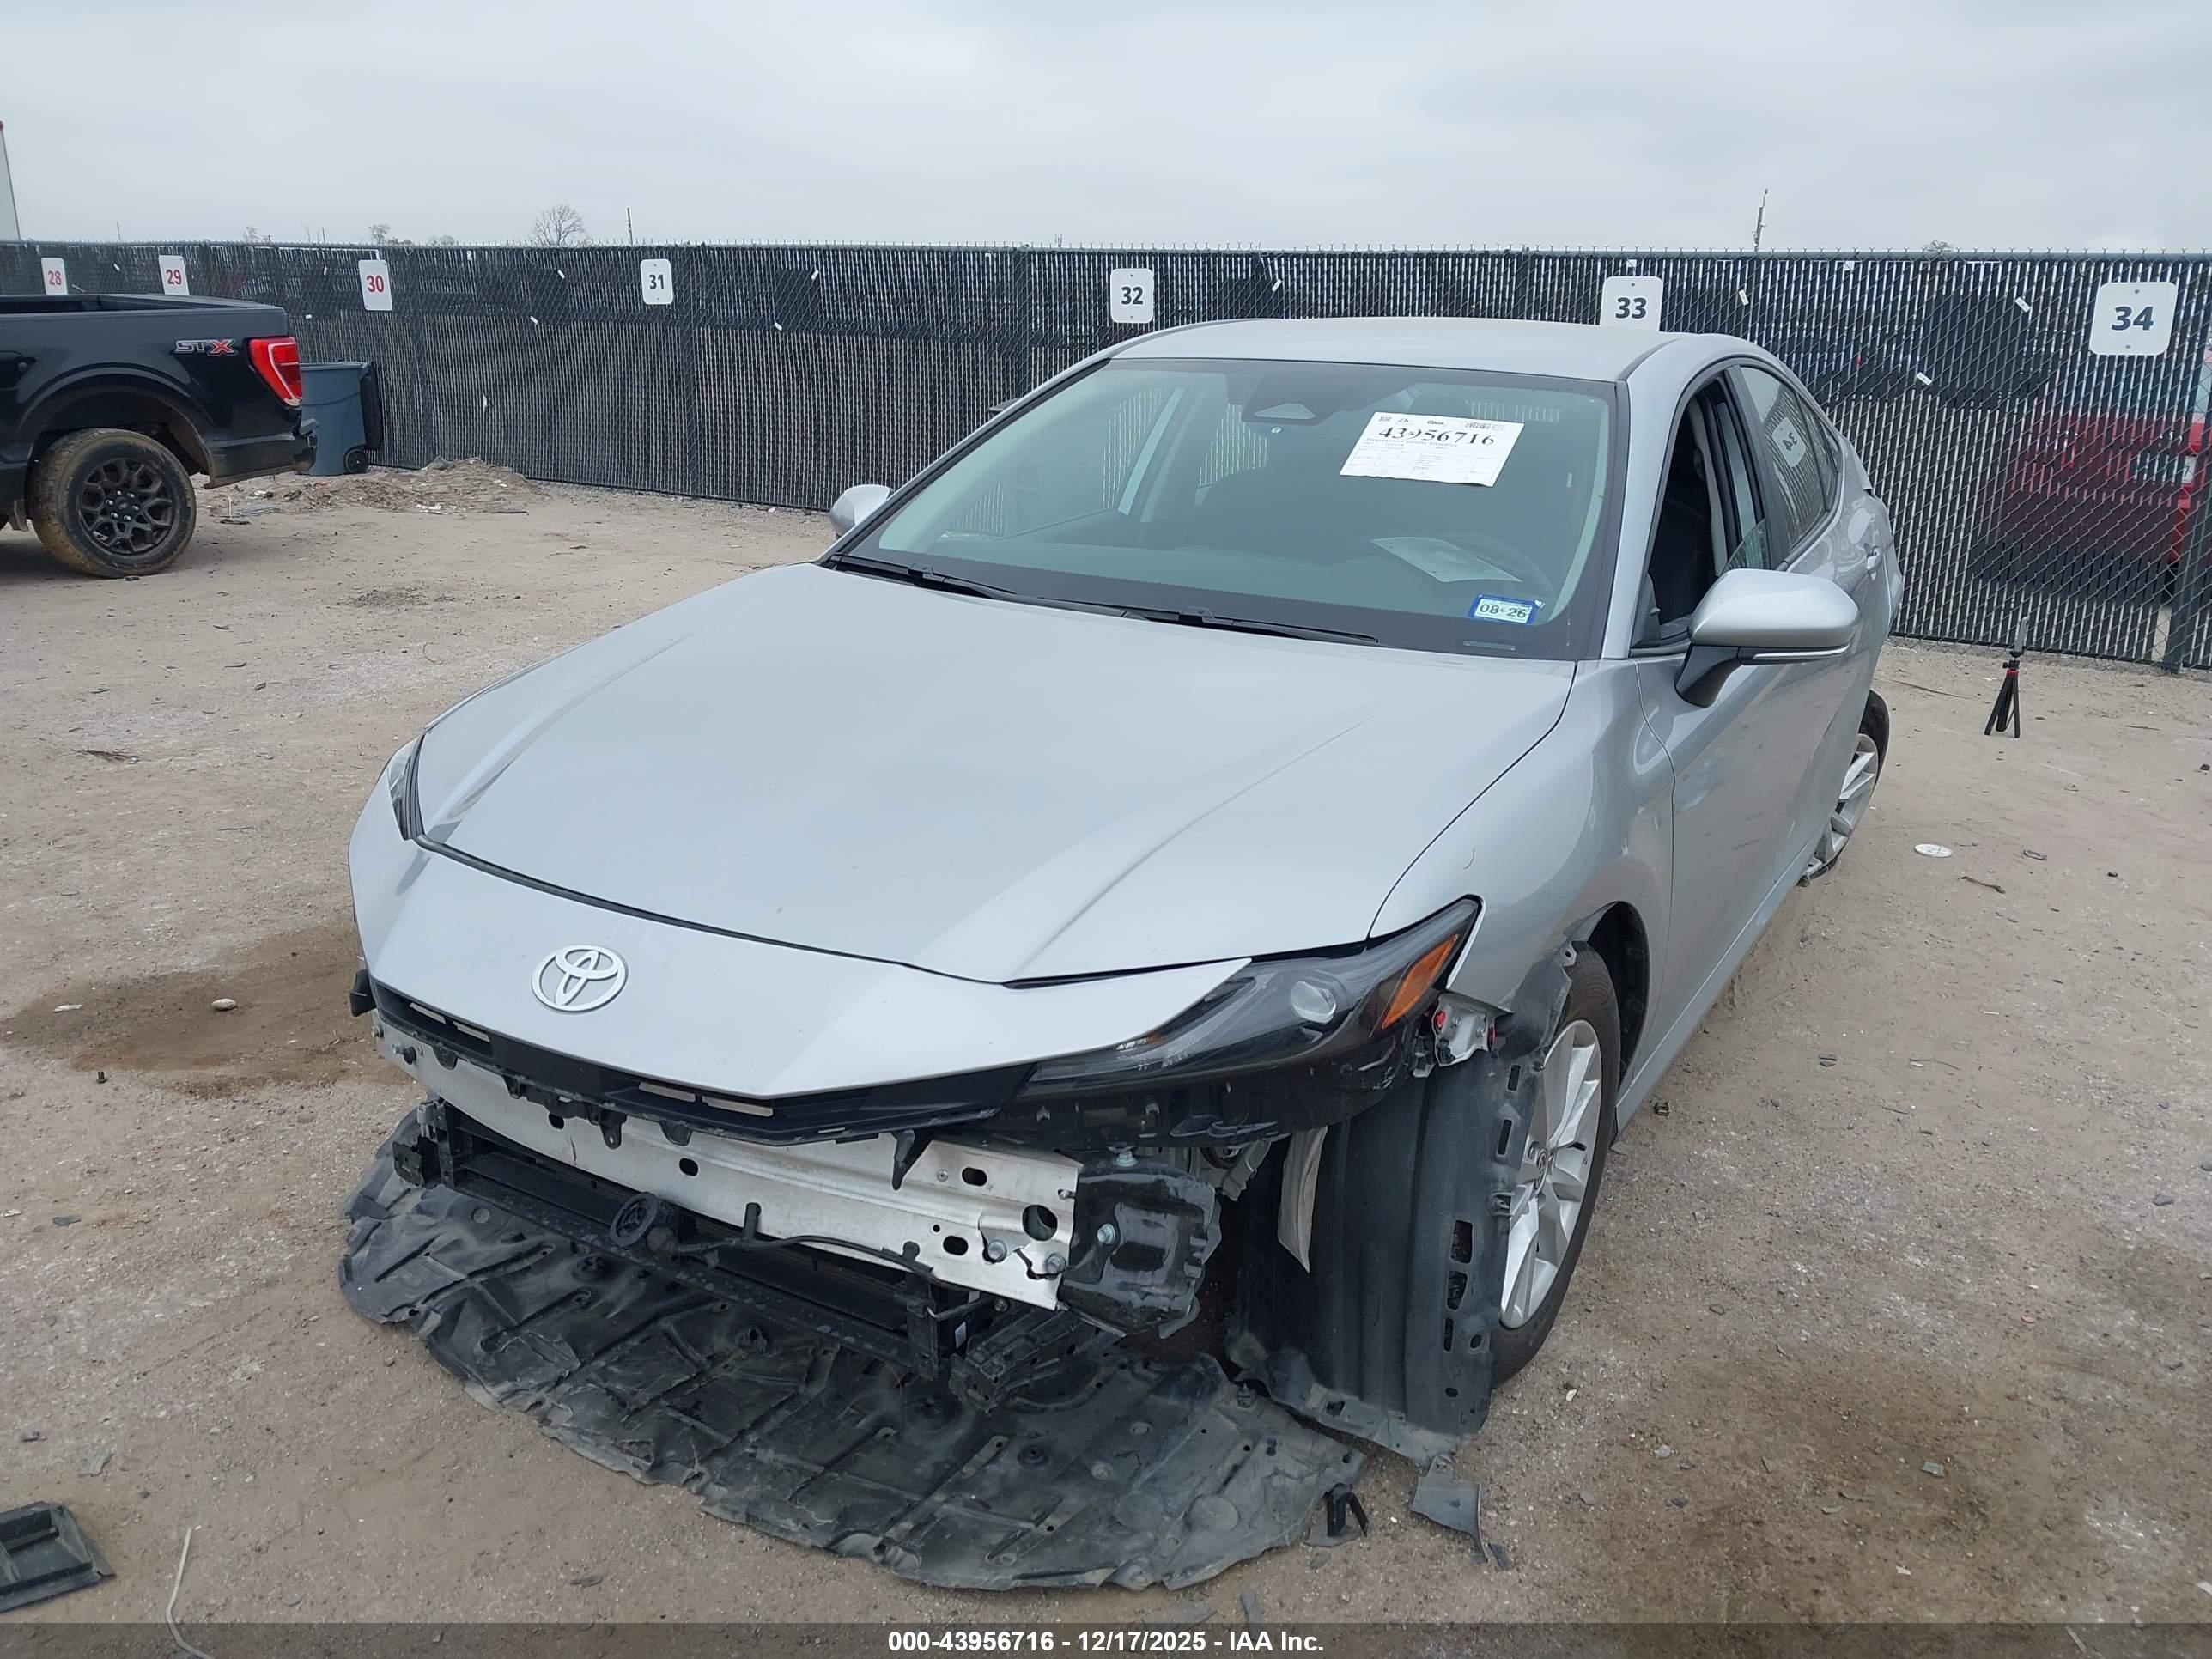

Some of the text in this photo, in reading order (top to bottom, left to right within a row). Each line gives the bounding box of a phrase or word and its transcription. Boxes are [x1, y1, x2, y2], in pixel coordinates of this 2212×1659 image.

[47, 270, 62, 286] 28
[166, 269, 182, 286] 29
[367, 275, 386, 294] 30
[648, 273, 665, 290] 31
[1121, 286, 1144, 305] 32
[1615, 297, 1648, 319] 33
[2111, 306, 2155, 332] 34
[174, 338, 238, 356] STX
[1378, 426, 1495, 447] 43956716
